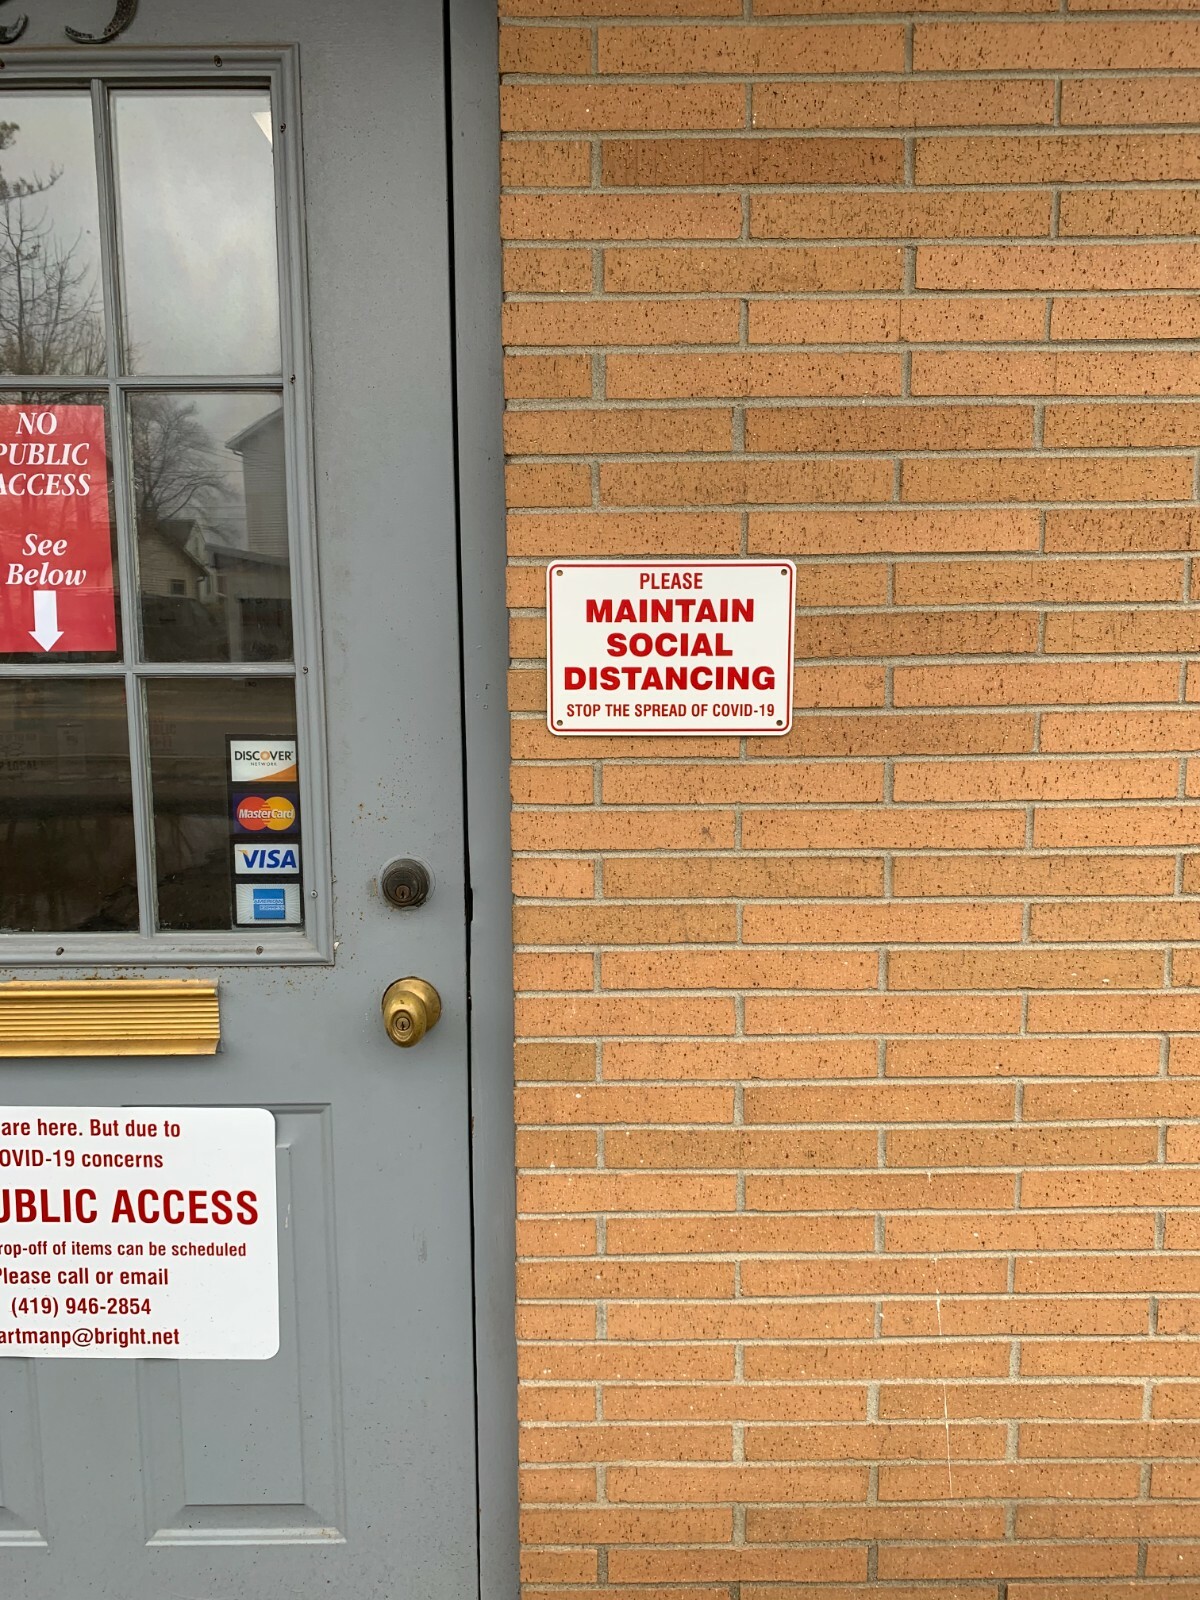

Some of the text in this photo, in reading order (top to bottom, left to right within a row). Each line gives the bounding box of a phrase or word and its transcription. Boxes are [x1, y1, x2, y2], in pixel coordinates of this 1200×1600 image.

[16, 412, 57, 435] NO
[23, 534, 67, 556] See
[6, 562, 86, 585] Below
[640, 573, 702, 589] PLEASE
[586, 599, 754, 622] MAINTAIN
[607, 633, 733, 657] SOCIAL
[565, 666, 775, 690] DISTANCING
[567, 704, 774, 717] STOP THE SPREAD OF COVID-19
[234, 751, 293, 761] DISCOVER
[239, 808, 294, 819] MasterCard
[241, 849, 297, 868] VISA
[2, 1119, 180, 1137] are here. But due to
[82, 1154, 163, 1168] concerns
[112, 1189, 258, 1225] ACCESS
[53, 1241, 66, 1255] of
[72, 1241, 112, 1255] items
[118, 1245, 143, 1255] can
[149, 1242, 166, 1256] be
[172, 1242, 246, 1256] scheduled
[0, 1268, 168, 1285] lease call or email
[12, 1297, 151, 1318] (419) 946-2854
